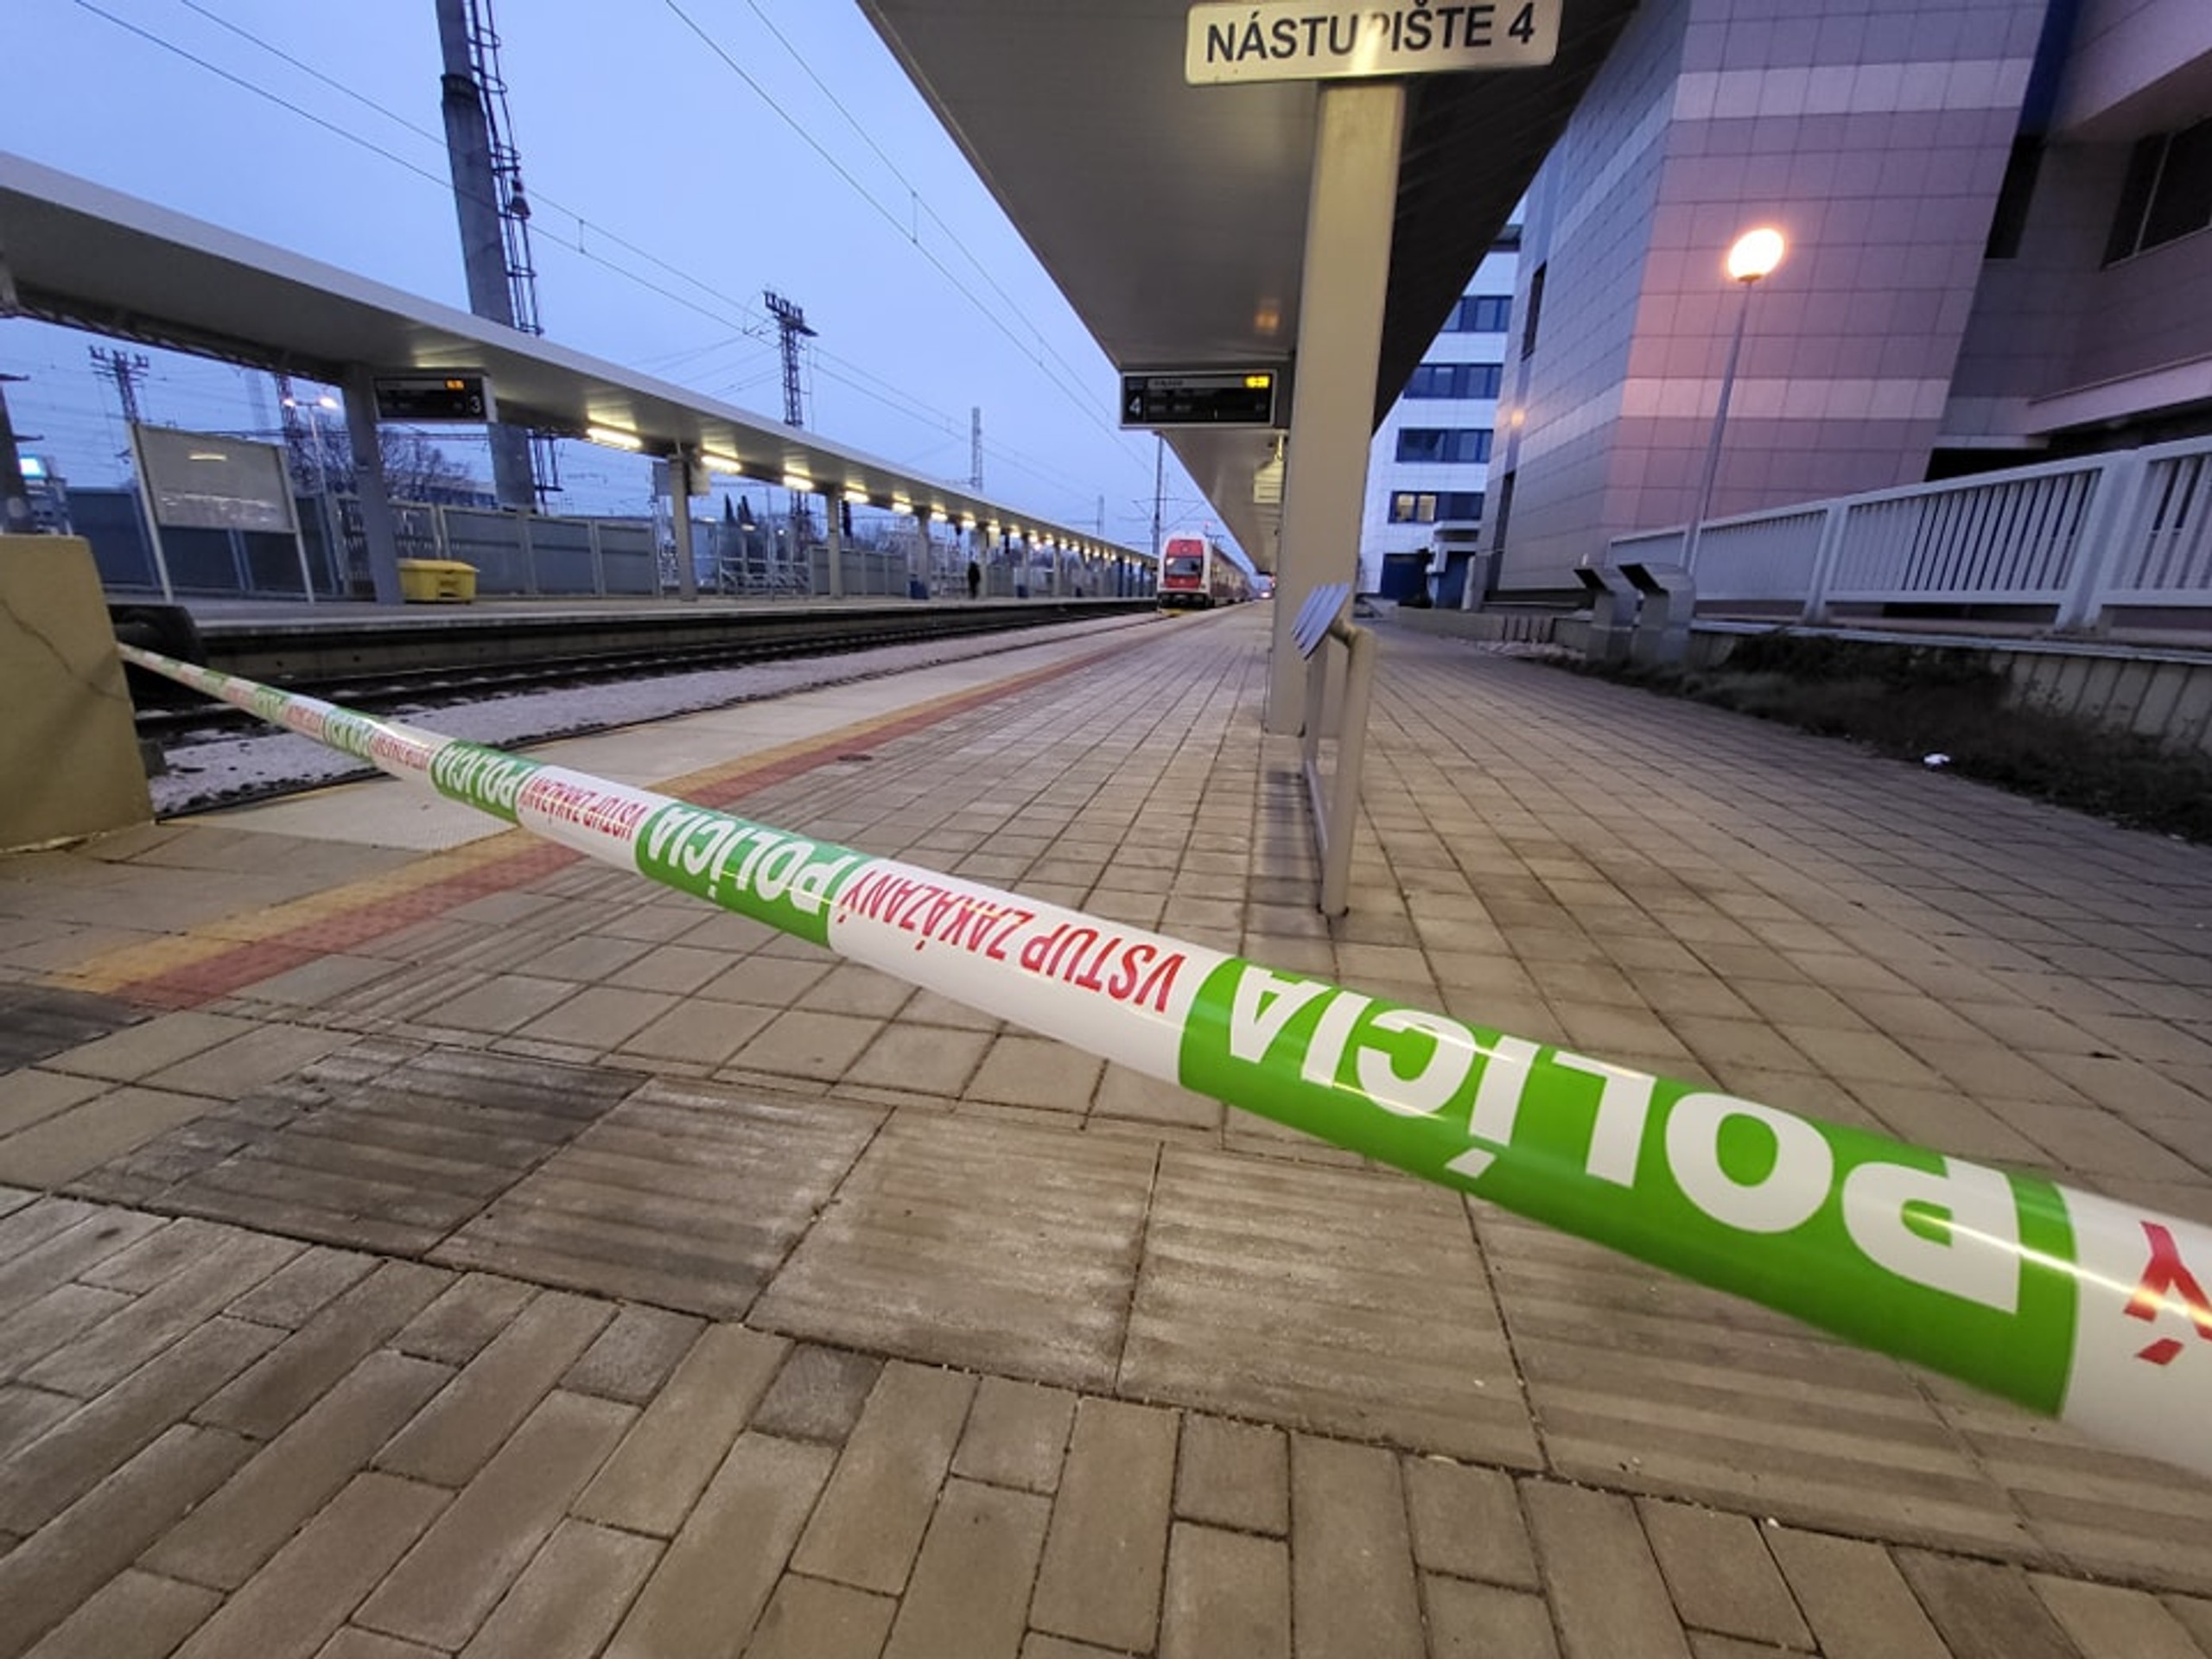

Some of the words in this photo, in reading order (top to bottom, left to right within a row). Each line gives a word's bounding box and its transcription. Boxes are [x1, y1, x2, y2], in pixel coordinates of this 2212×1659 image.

[1508, 3, 1535, 44] 4
[470, 396, 481, 414] 3
[1128, 397, 1141, 416] 4
[648, 806, 860, 916] POLÍCIA
[837, 870, 1034, 962] ZAKÁZANÝ
[1020, 923, 1186, 1014] VSTUP
[1229, 964, 2020, 1315] POLÍCIA
